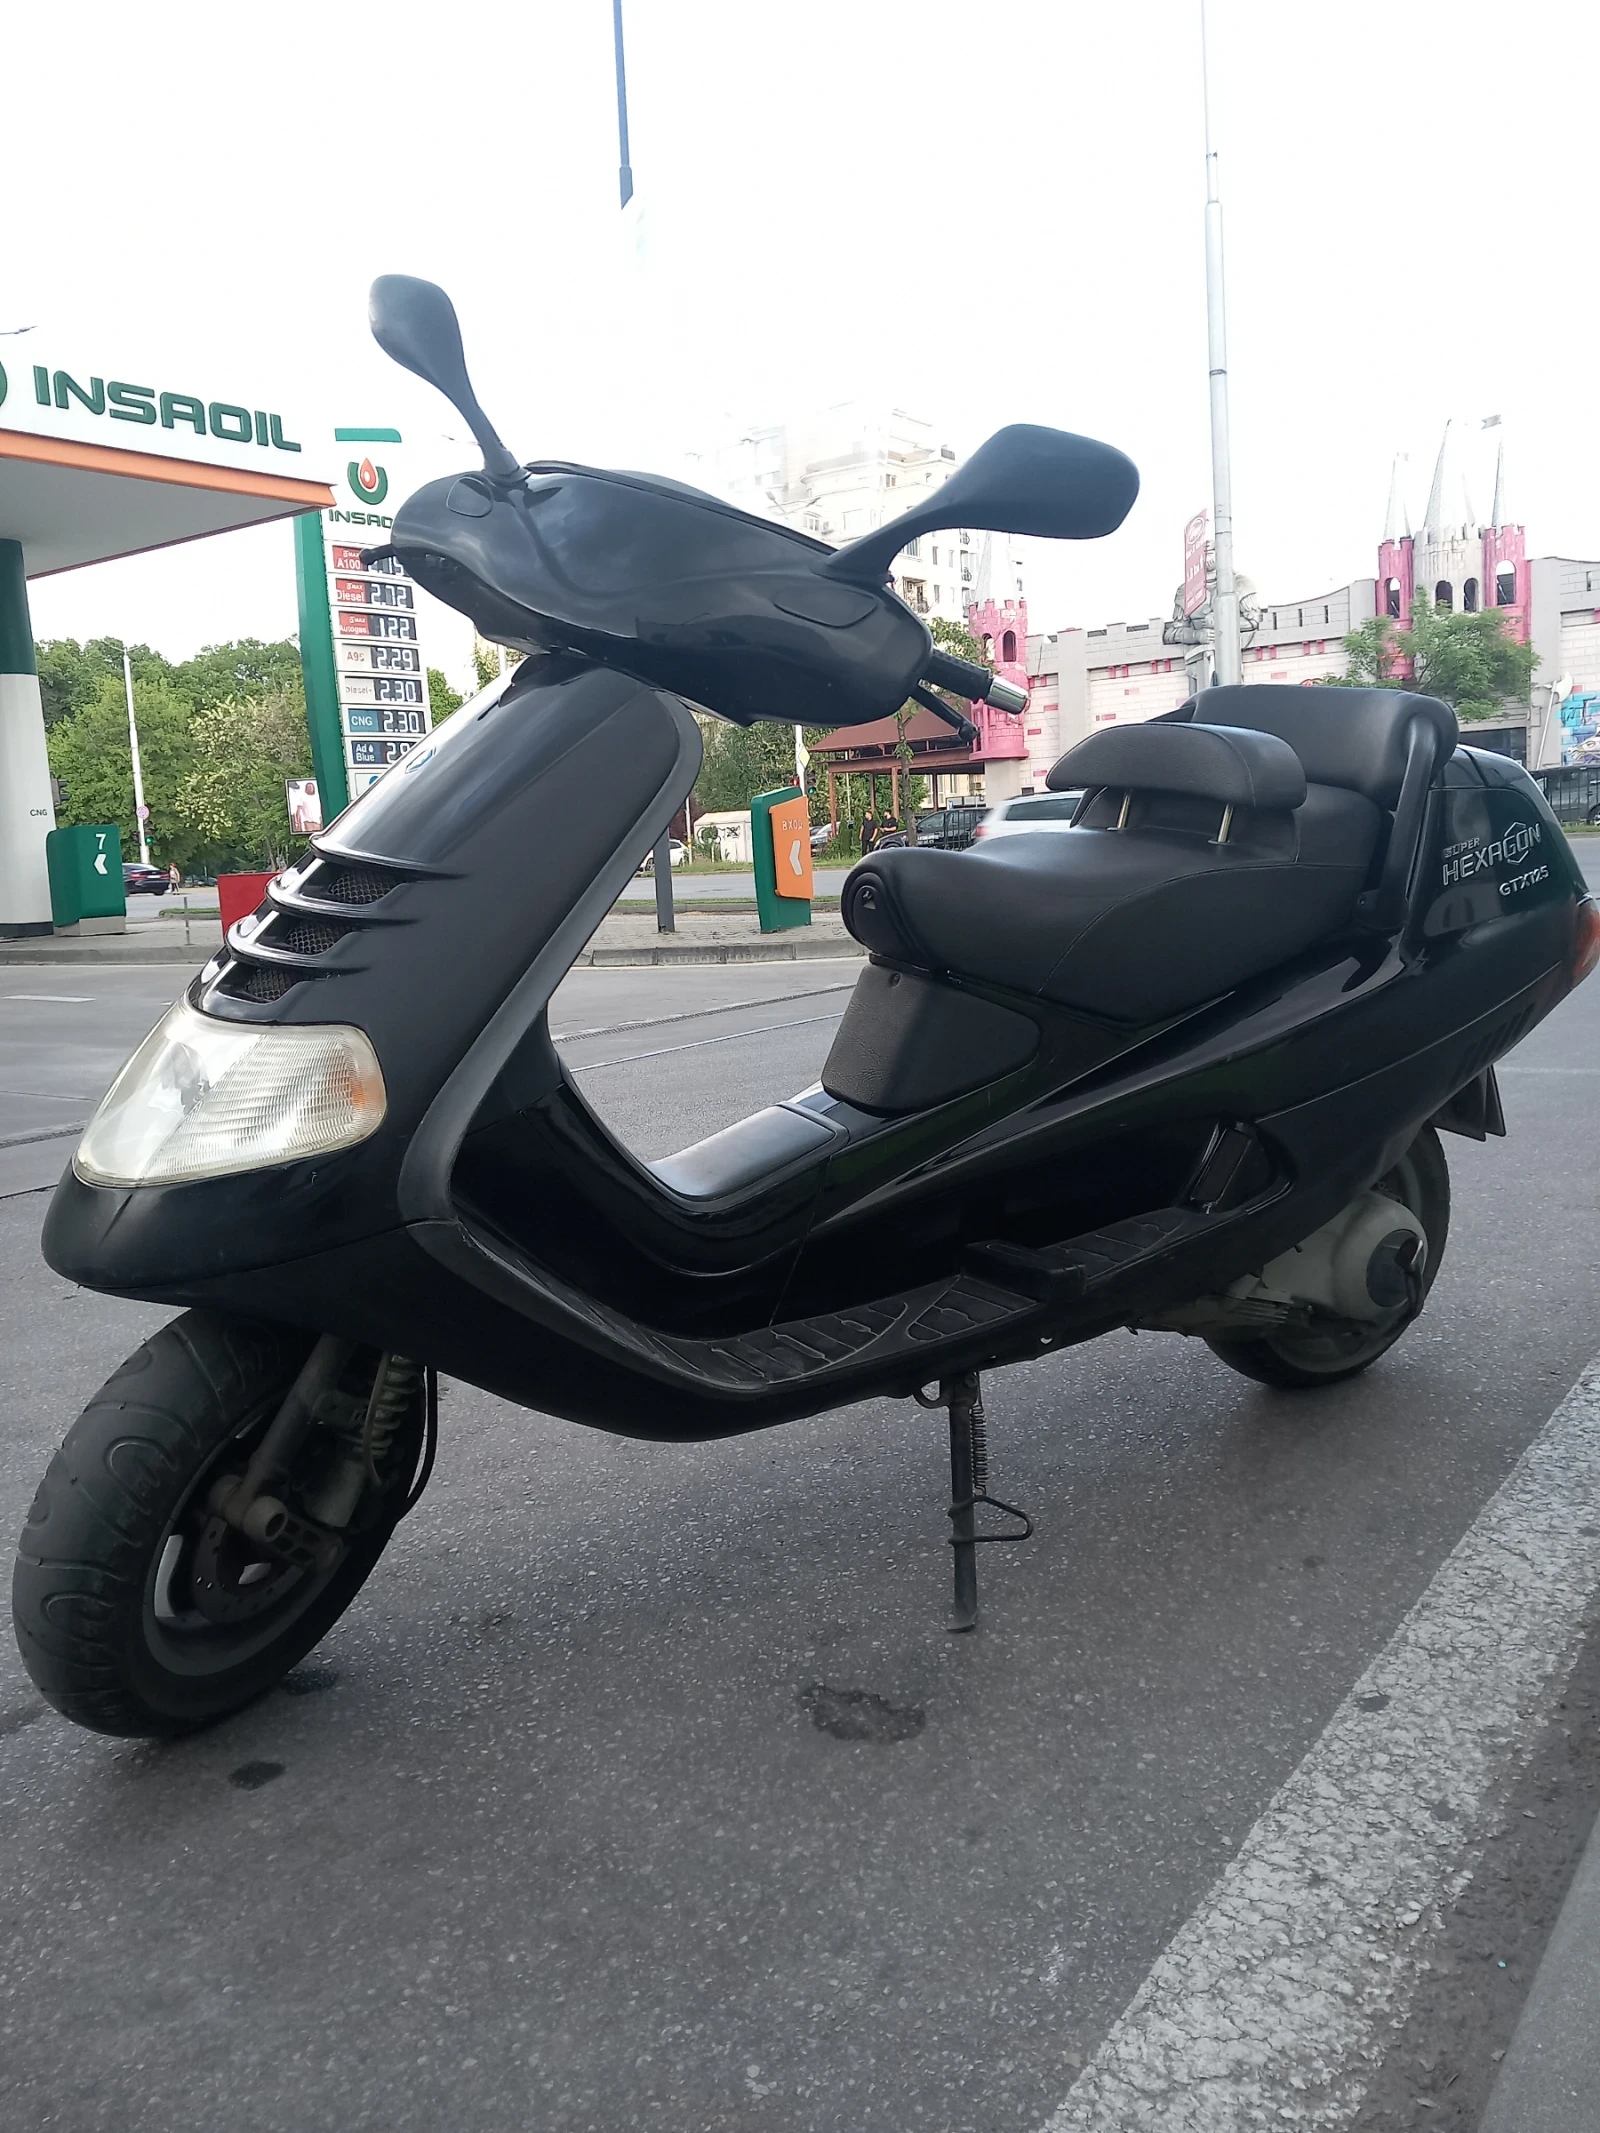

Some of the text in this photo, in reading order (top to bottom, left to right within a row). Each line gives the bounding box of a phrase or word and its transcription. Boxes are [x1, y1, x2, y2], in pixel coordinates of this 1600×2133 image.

[33, 365, 301, 452] INSAOIL
[329, 509, 393, 529] INSAO
[337, 558, 361, 570] A100
[336, 589, 365, 602] Diesel
[371, 583, 407, 608] 2.72
[377, 647, 413, 671] 2.29
[380, 680, 416, 702] 2.30
[351, 715, 373, 726] CNG
[383, 711, 420, 733] 2.30
[355, 743, 367, 753] Ad
[355, 752, 375, 762] Blue
[29, 809, 48, 817] CNG
[95, 833, 107, 850] 7
[1443, 837, 1481, 859] SUPER
[1442, 822, 1542, 886] HEXAGON
